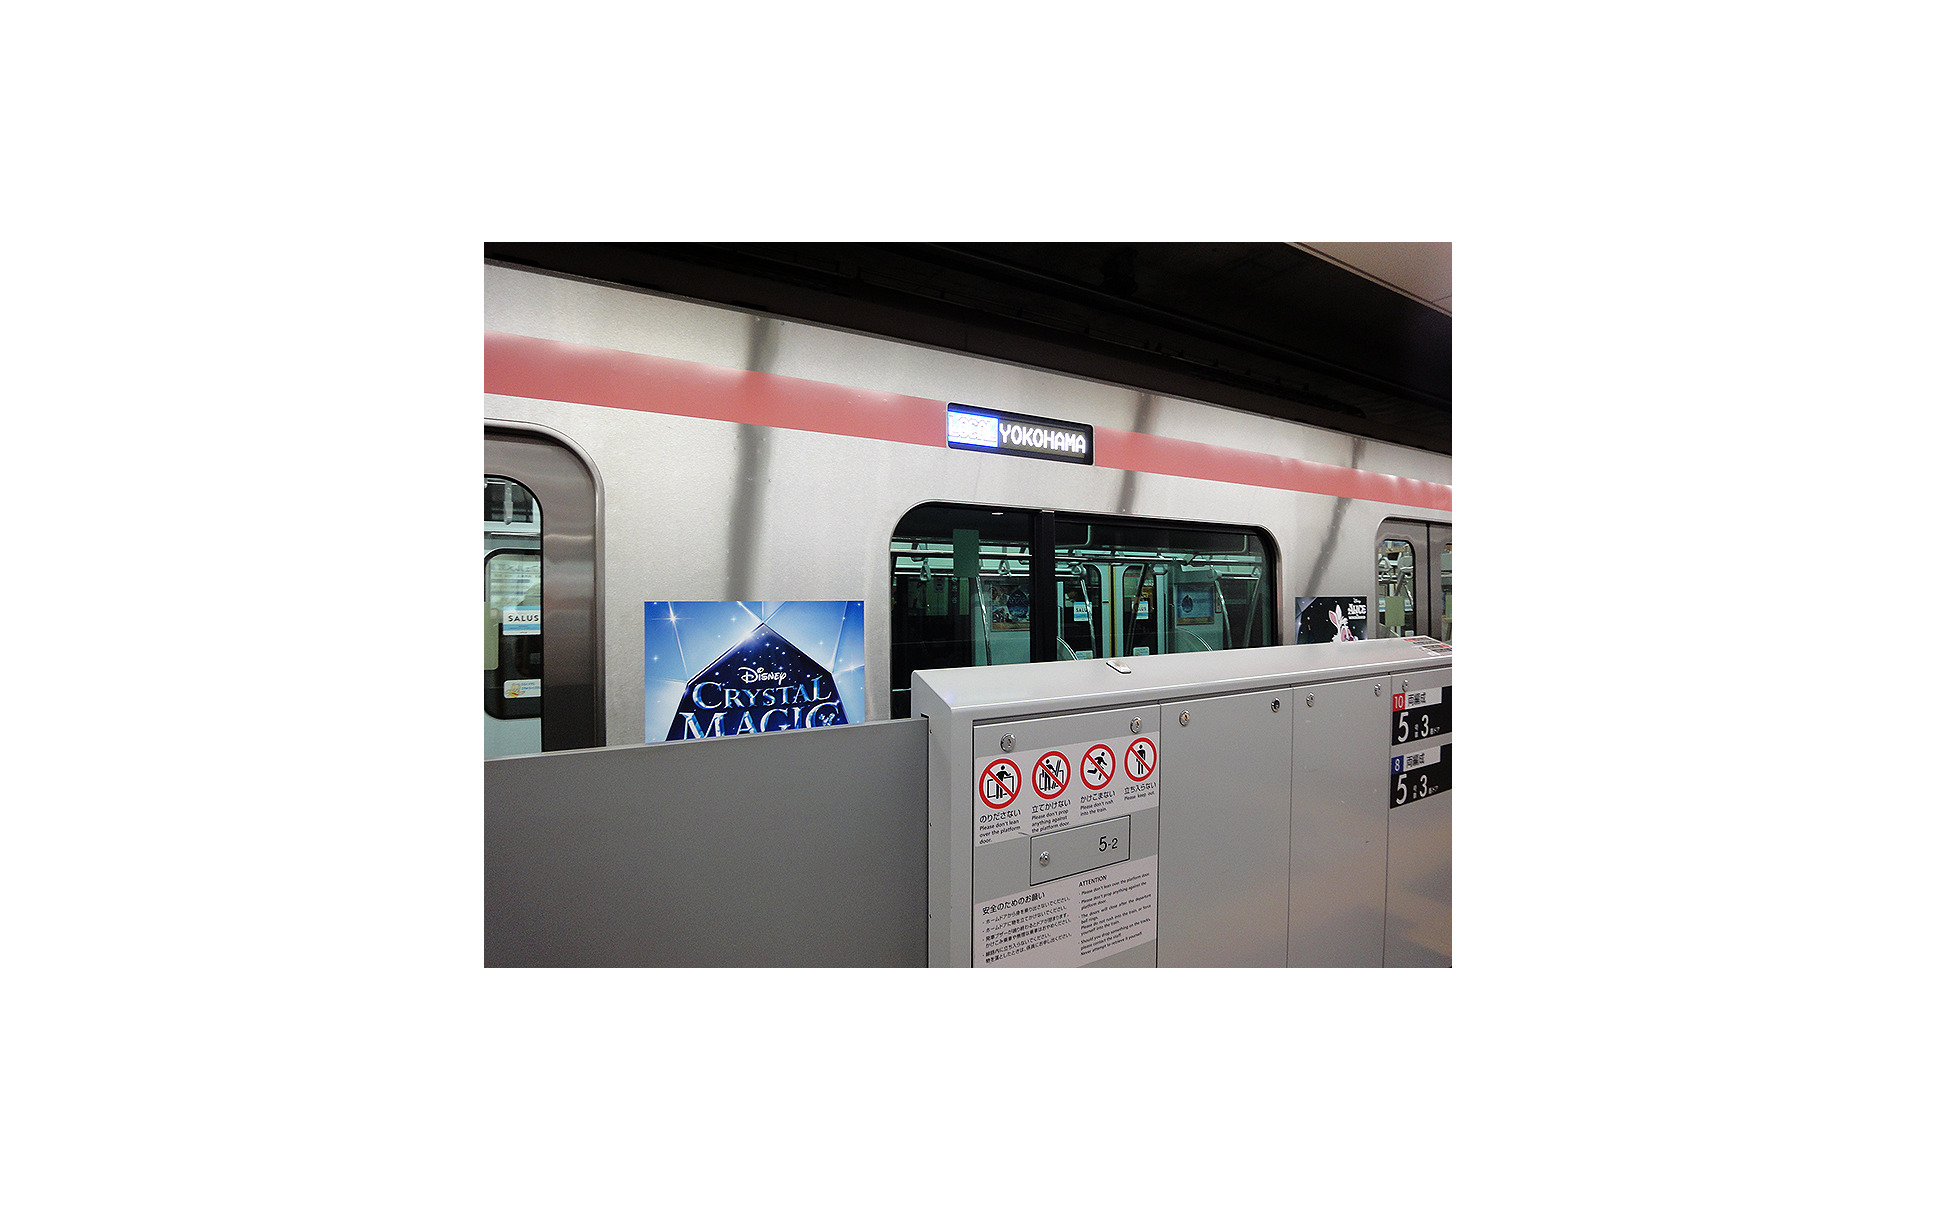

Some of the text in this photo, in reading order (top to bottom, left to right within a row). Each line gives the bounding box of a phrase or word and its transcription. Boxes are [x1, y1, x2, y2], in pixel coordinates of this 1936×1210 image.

[999, 422, 1086, 454] YOKOHAMA
[692, 675, 832, 710] CRYSTAL
[1395, 696, 1403, 708] 10
[679, 700, 839, 740] MAGIC
[1398, 712, 1409, 742] 5
[1421, 715, 1428, 737] 3
[1394, 758, 1400, 772] 8
[1124, 782, 1157, 794] 立ち入らない
[1396, 774, 1407, 805] 5
[1420, 775, 1427, 797] 3
[1080, 791, 1116, 803] かけこまない
[1032, 800, 1071, 813] 立てかけない
[980, 809, 1021, 823] のりださない
[1001, 826, 1020, 834] platform
[1040, 824, 1058, 832] platform
[1099, 836, 1118, 851] 5-2
[1079, 875, 1108, 887] ATTENTION
[983, 892, 1045, 915] 安全のためのお願い
